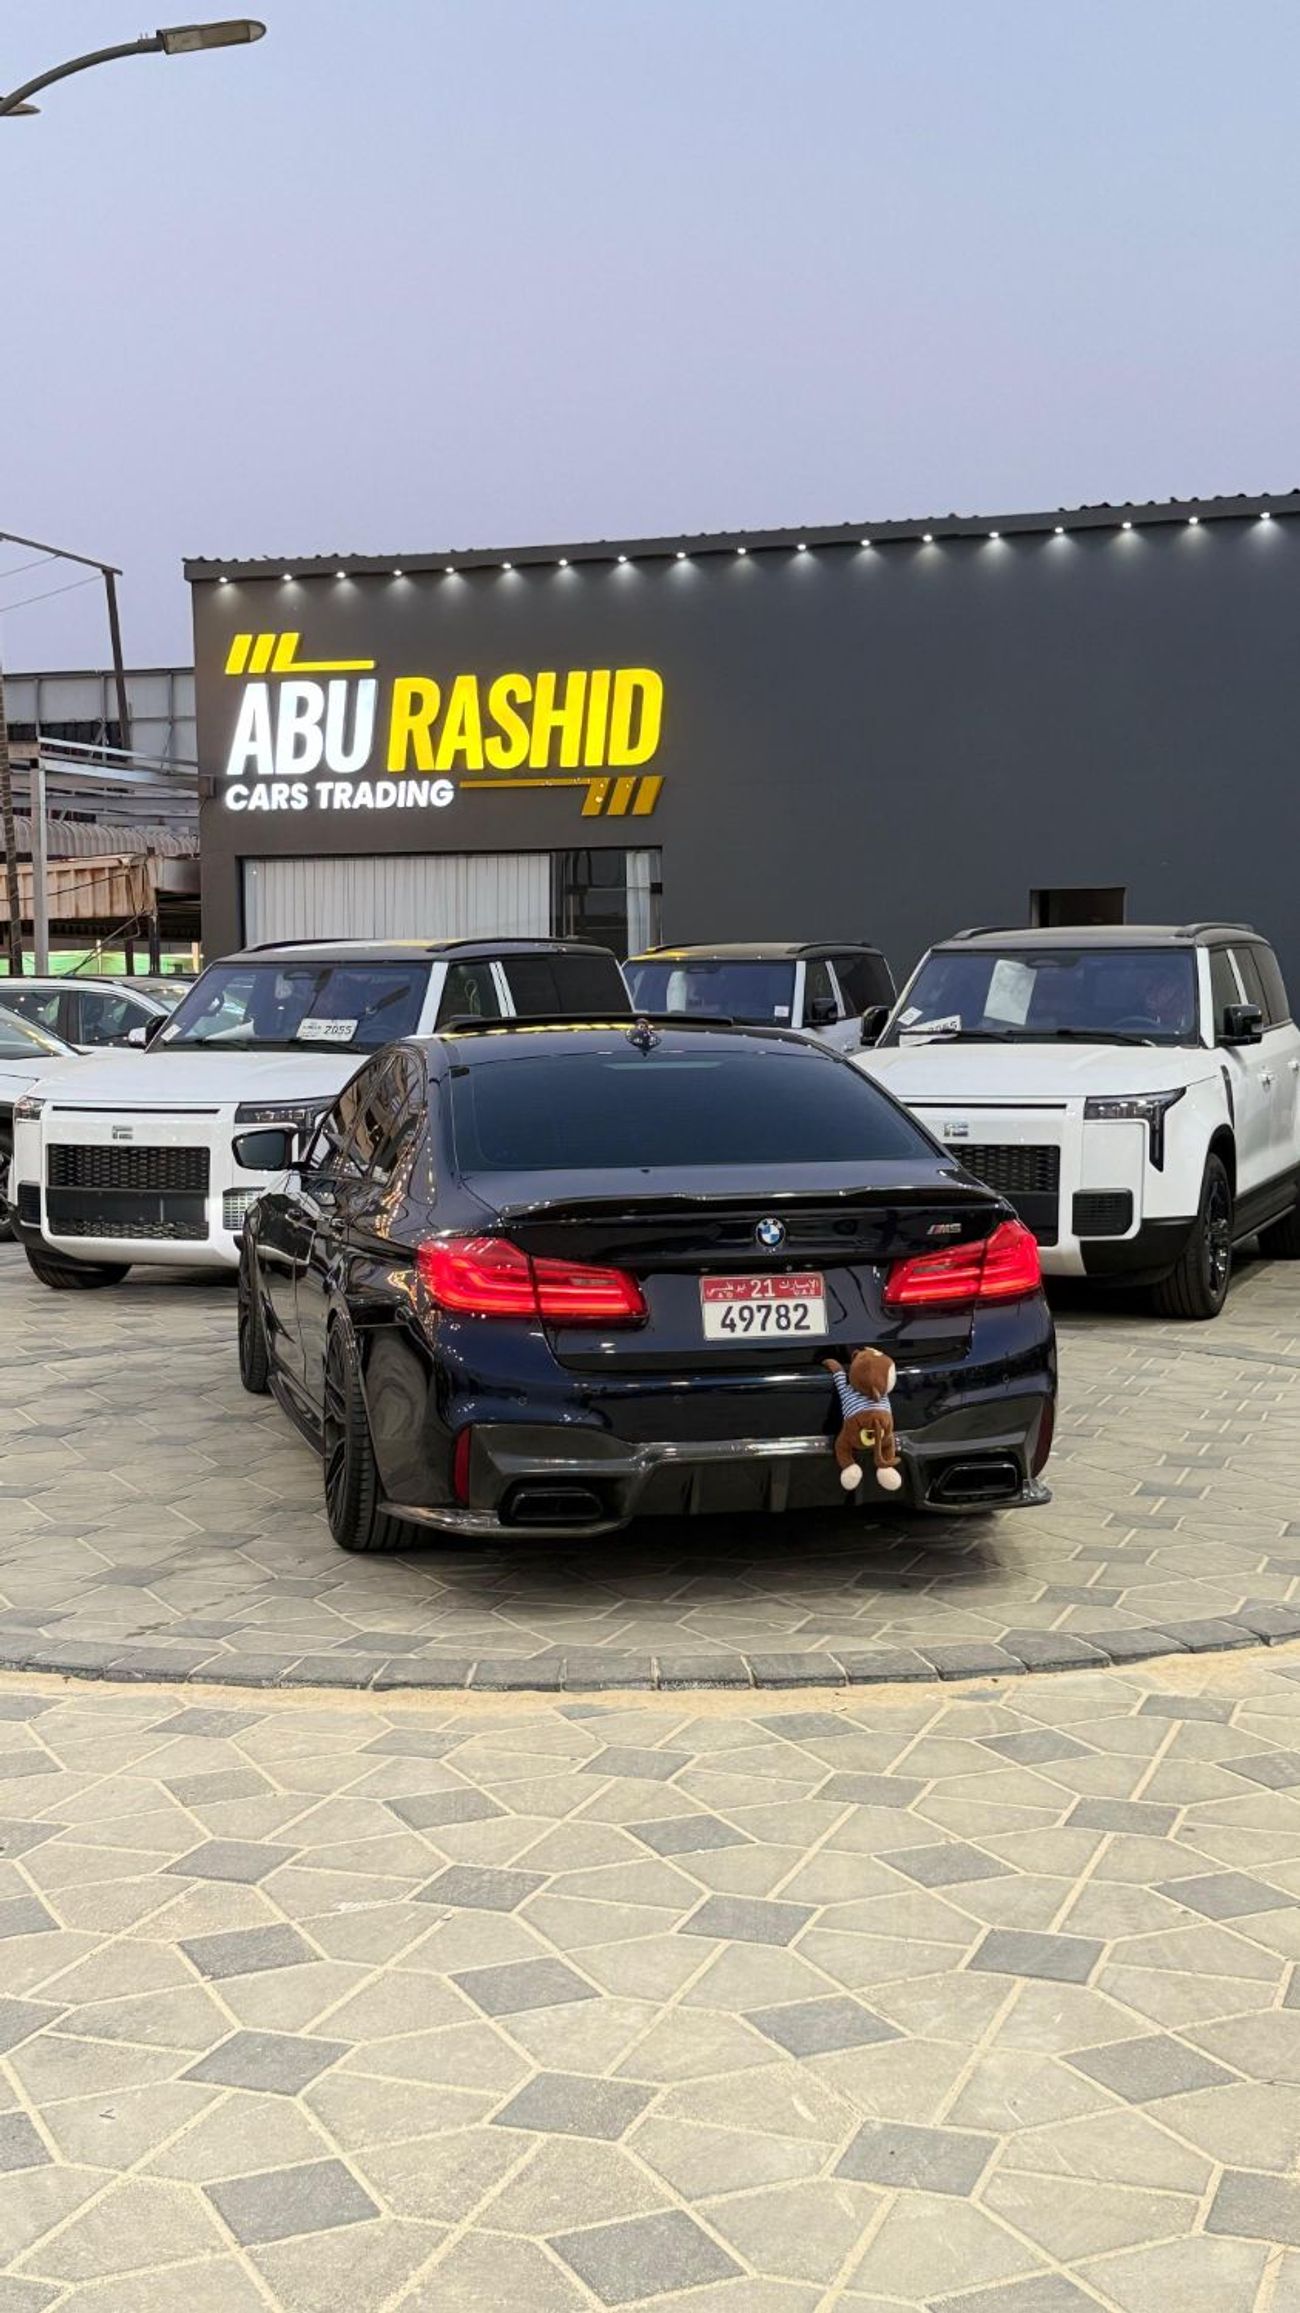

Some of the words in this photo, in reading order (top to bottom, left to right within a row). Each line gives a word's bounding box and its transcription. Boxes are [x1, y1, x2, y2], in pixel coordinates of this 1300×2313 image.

[227, 678, 378, 776] ABU
[386, 667, 664, 772] RASHID
[225, 782, 308, 811] CARS
[314, 778, 455, 810] TRADING
[750, 1279, 775, 1298] 21
[720, 1303, 811, 1333] 49782
